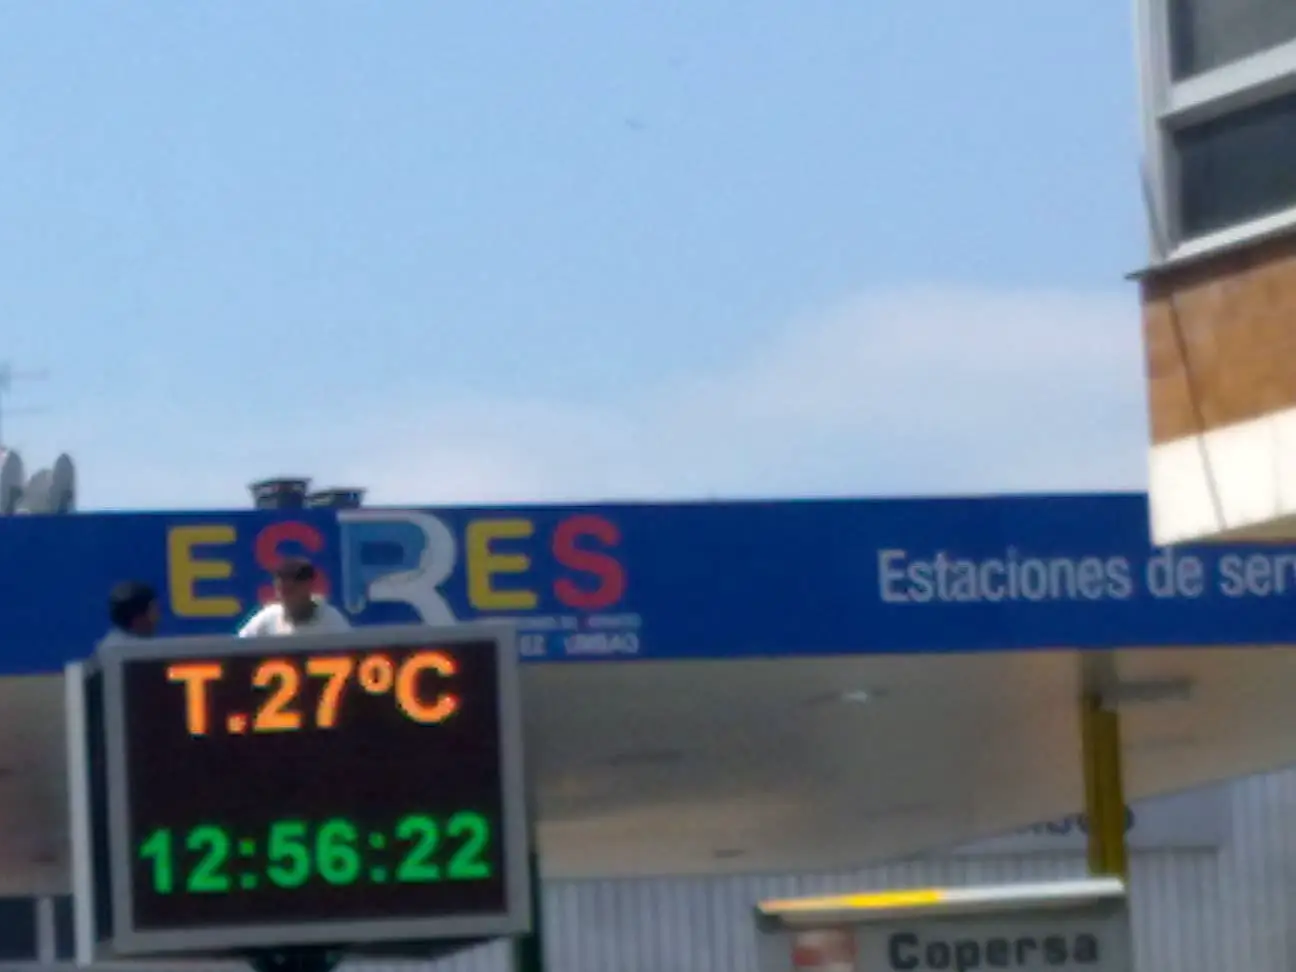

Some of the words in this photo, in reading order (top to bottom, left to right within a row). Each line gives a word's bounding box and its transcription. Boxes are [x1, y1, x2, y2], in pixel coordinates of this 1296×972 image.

[878, 547, 1133, 603] Estaciones
[1147, 546, 1204, 598] de
[1218, 553, 1296, 598] ser
[139, 811, 491, 894] 12:56:22
